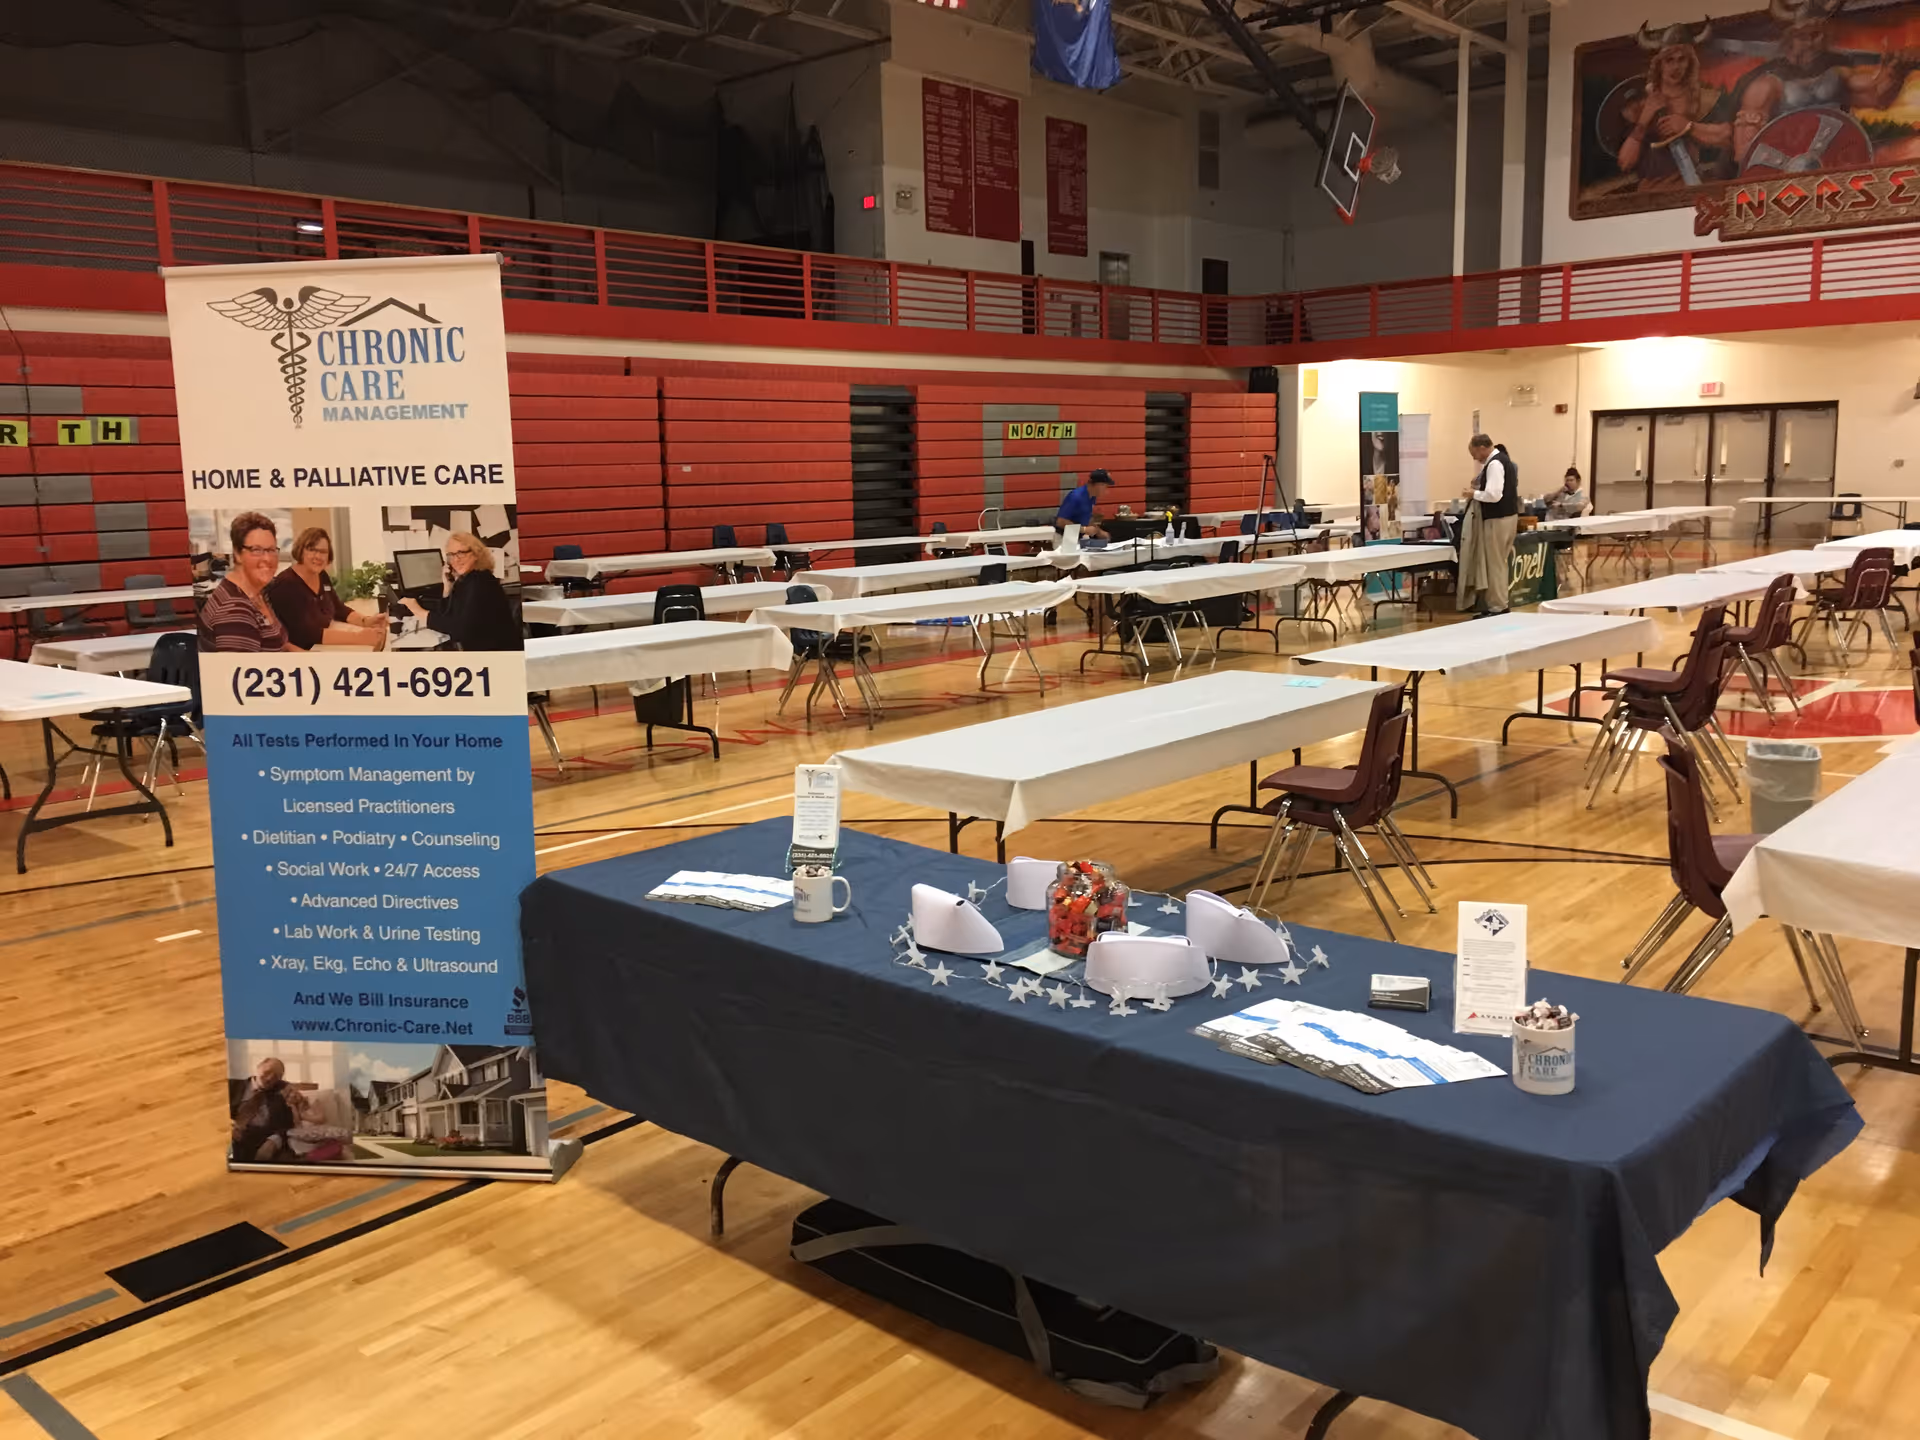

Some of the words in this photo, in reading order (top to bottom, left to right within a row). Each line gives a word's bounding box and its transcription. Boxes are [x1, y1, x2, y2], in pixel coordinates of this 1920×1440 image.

[1735, 168, 1920, 222] NORSE
[317, 326, 466, 366] CHRONIC
[320, 369, 405, 402] CARE
[322, 403, 468, 422] MANAGEMENT
[1011, 424, 1073, 438] NORTH
[191, 468, 262, 490] HOME
[269, 468, 286, 488] &
[293, 466, 427, 488] PALLIATIVE
[434, 463, 505, 485] CARE
[231, 666, 321, 706] (231)
[332, 666, 492, 698] 421-6921
[232, 733, 253, 748] All
[257, 733, 301, 748] Tests
[304, 733, 391, 748] Performed
[394, 733, 410, 748] In
[411, 733, 452, 749] Your
[455, 734, 504, 749] Home
[269, 766, 344, 785] Symptom
[349, 766, 453, 785] Management
[456, 767, 476, 786] by
[282, 798, 354, 815] Licensed
[358, 798, 455, 816] Practitioners
[253, 829, 316, 846] Dietitian
[332, 830, 396, 850] Podiatry
[411, 831, 501, 851] Counseling
[277, 860, 324, 877] Social
[329, 861, 370, 878] Work
[384, 862, 419, 878] 24/7
[423, 863, 480, 879] Access
[300, 893, 378, 909] Advanced
[382, 894, 459, 911] Directives
[284, 924, 312, 940] Lab
[316, 924, 358, 940] Work
[362, 925, 375, 941] &
[379, 925, 421, 941] Urine
[424, 926, 481, 945] Testing
[270, 955, 309, 974] Xray,
[352, 957, 392, 972] Echo
[396, 957, 409, 972] &
[412, 957, 499, 974] Ultrasound
[293, 992, 325, 1008] And
[328, 992, 354, 1008] We
[358, 992, 385, 1008] Bill
[388, 993, 470, 1009] Insurance
[291, 1017, 474, 1036] www.Chronic-Care.Net
